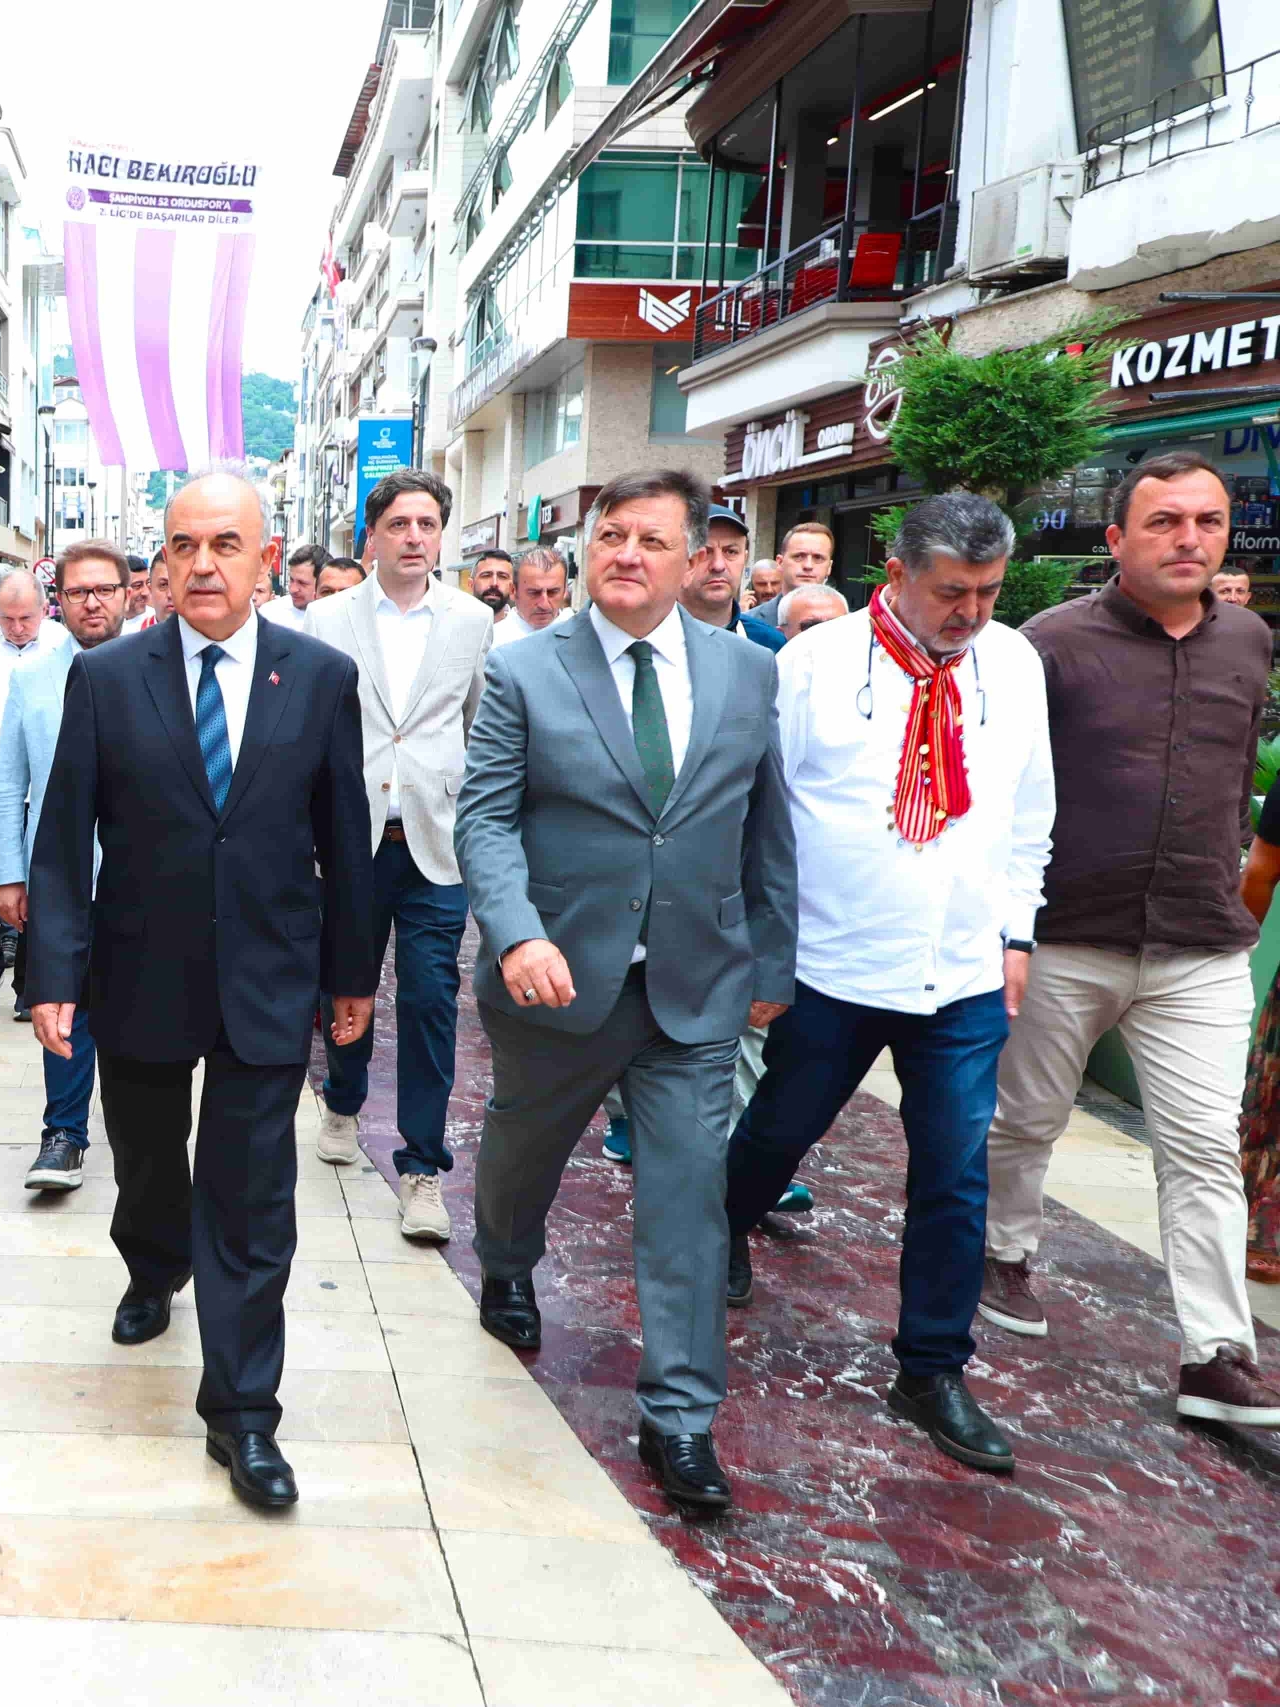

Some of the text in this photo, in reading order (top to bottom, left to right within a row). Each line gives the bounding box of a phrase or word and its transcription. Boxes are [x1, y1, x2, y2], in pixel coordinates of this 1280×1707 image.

[67, 150, 120, 178] HACI
[108, 193, 232, 210] ŞAMPİYON 52 ORDUSPOR'A
[110, 207, 143, 220] LİG'DE
[146, 211, 205, 224] BAŞARILAR
[208, 214, 239, 224] DİLER
[1110, 315, 1280, 388] KOZMET
